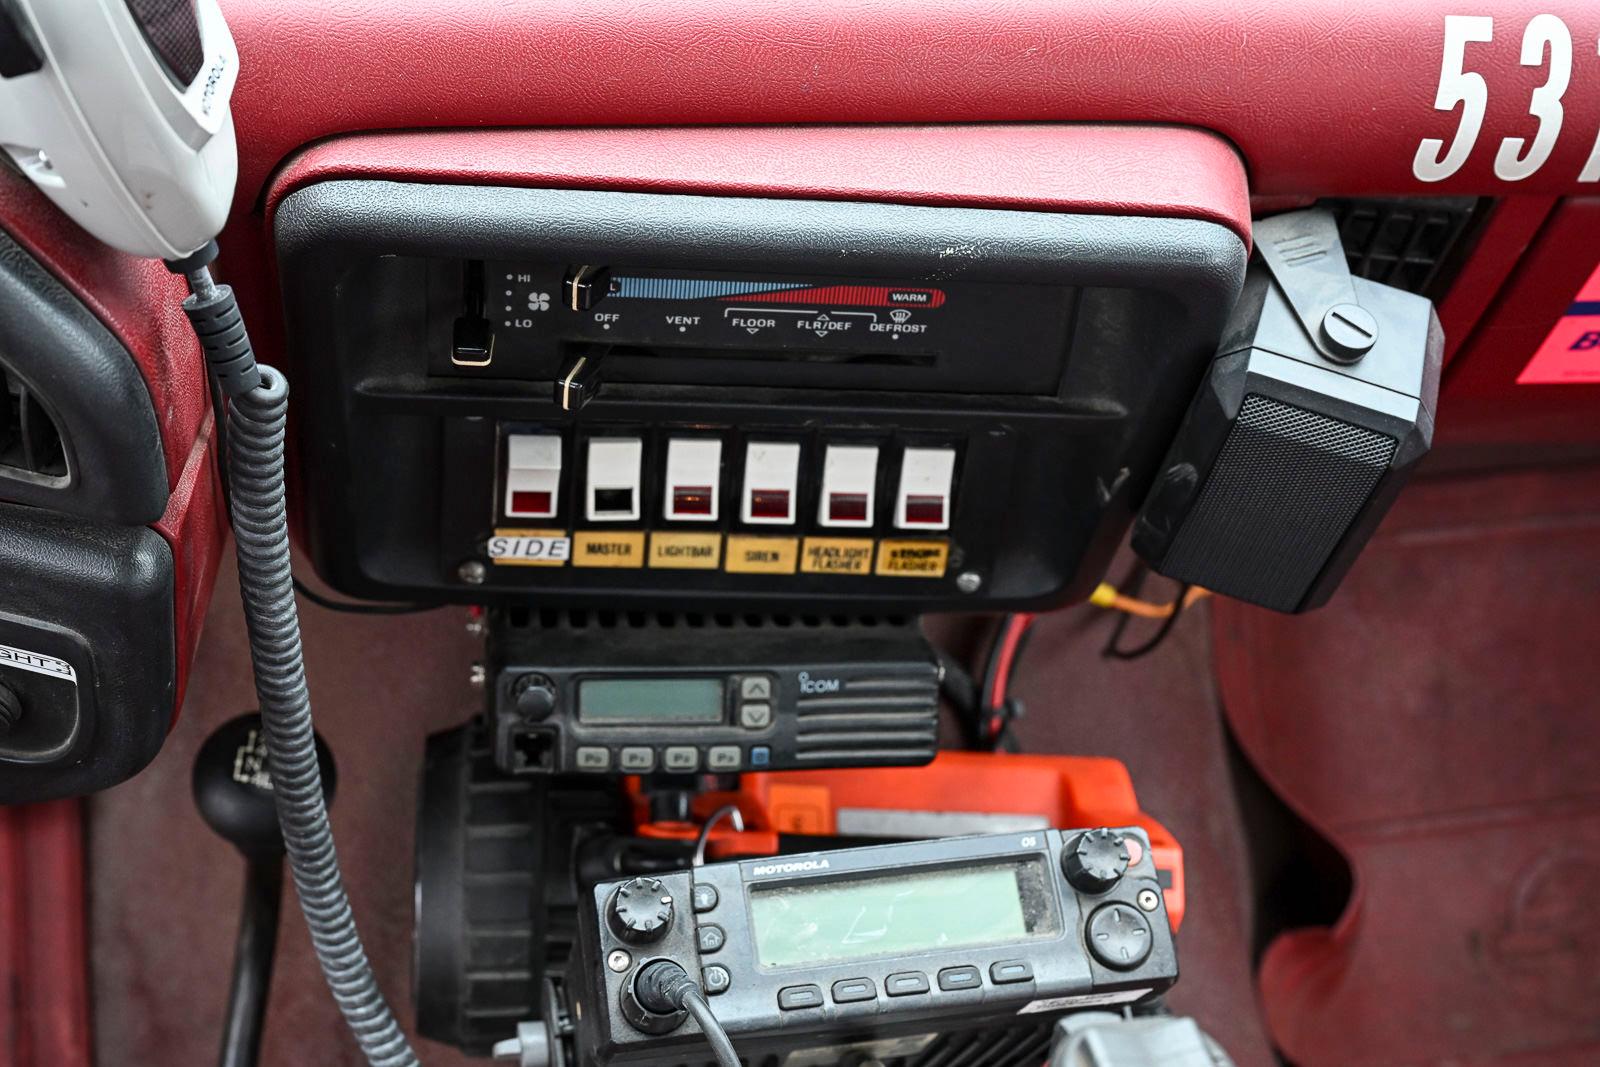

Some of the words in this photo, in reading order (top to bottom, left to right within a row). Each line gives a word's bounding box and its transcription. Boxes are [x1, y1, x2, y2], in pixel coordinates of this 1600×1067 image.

[1412, 13, 1600, 182] 53
[517, 274, 531, 283] HI
[892, 293, 927, 302] WARM
[594, 312, 620, 322] OFF
[665, 315, 700, 325] VENT
[515, 319, 532, 328] LO
[732, 318, 776, 328] FLOOR
[796, 320, 852, 331] FLR/DEF
[869, 323, 927, 333] DEFROST
[490, 537, 566, 558] SIDE
[586, 542, 631, 556] MASTER
[657, 543, 713, 558] LIGHTBAR
[807, 546, 869, 560] HEADLIGHT
[744, 550, 779, 563] SIREN
[753, 859, 830, 876] MOTOROLA
